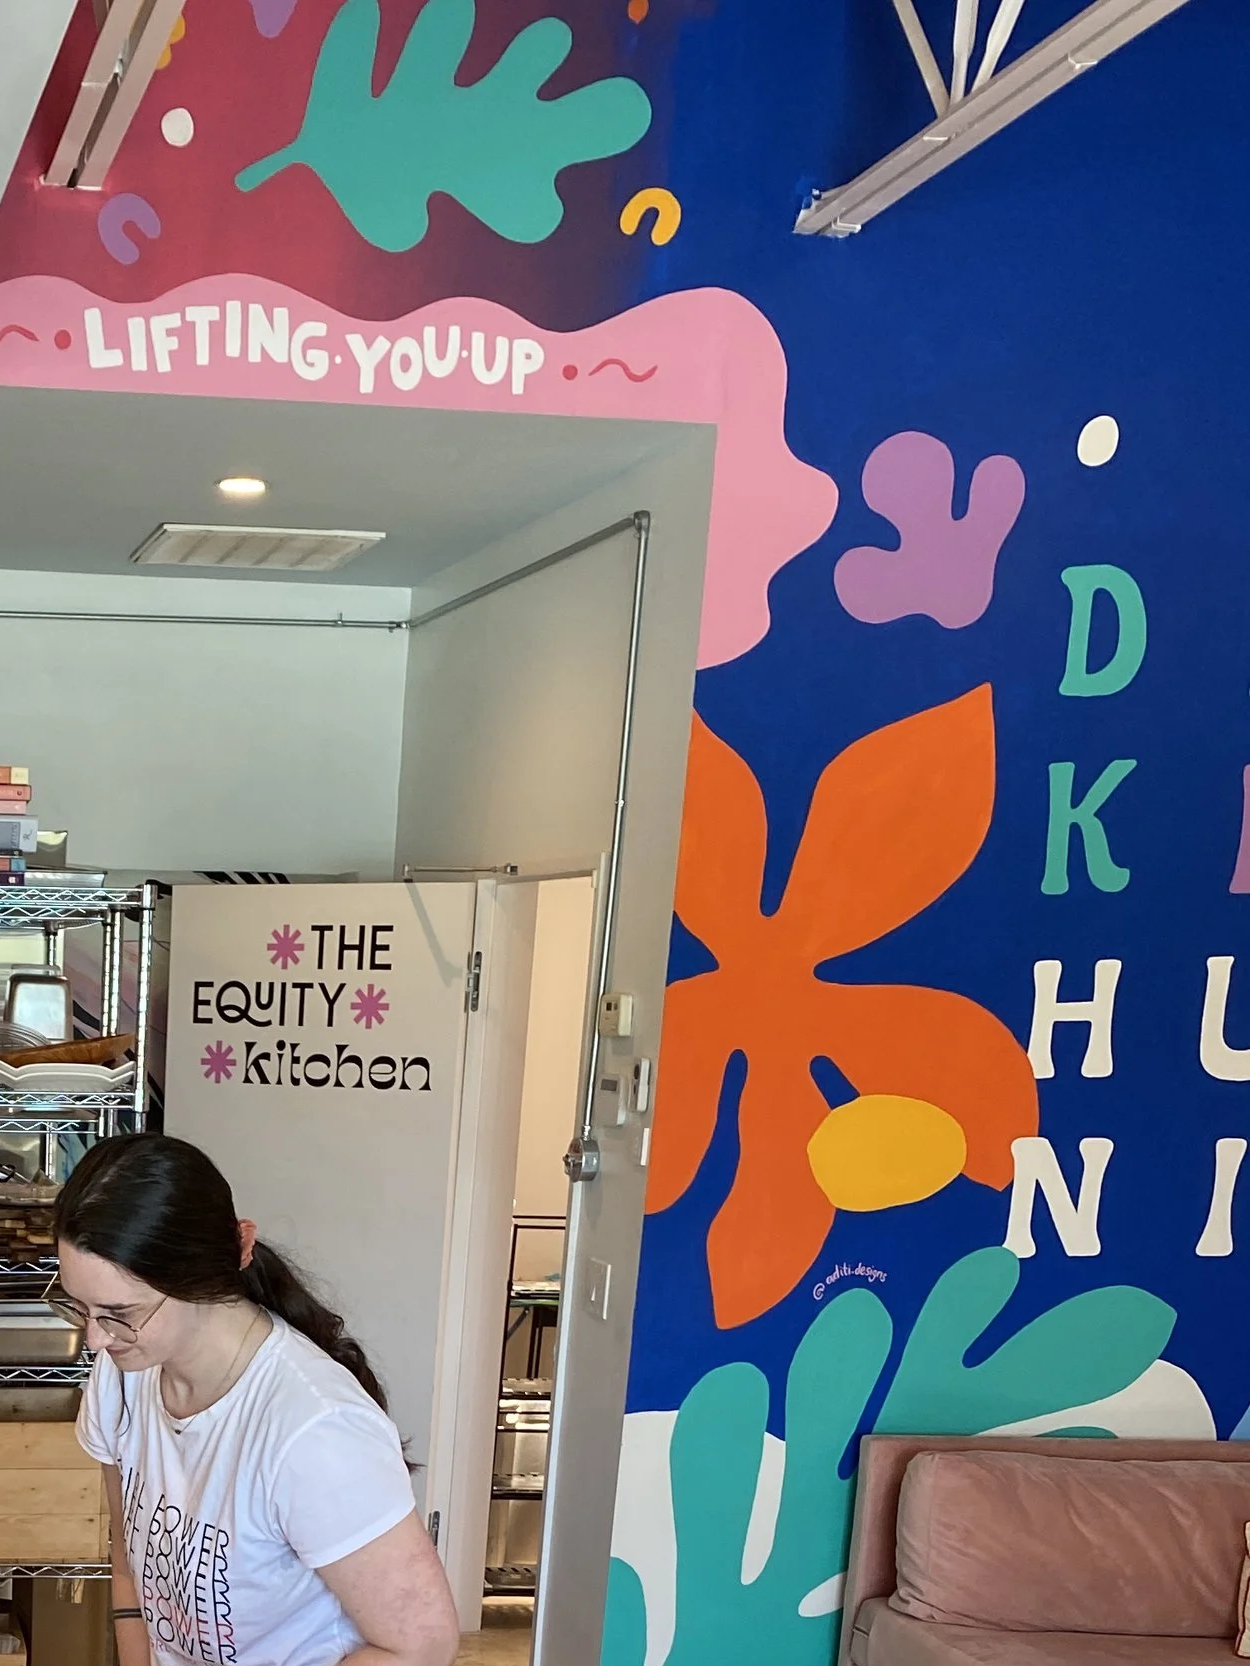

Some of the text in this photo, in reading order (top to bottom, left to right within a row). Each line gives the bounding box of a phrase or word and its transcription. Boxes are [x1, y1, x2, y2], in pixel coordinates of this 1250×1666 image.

[84, 301, 545, 395] LIFTING YOU UP
[1059, 564, 1147, 697] D
[1041, 759, 1138, 895] K
[311, 925, 394, 970] THE
[192, 980, 347, 1028] EQUITY
[242, 1039, 432, 1091] kitchen
